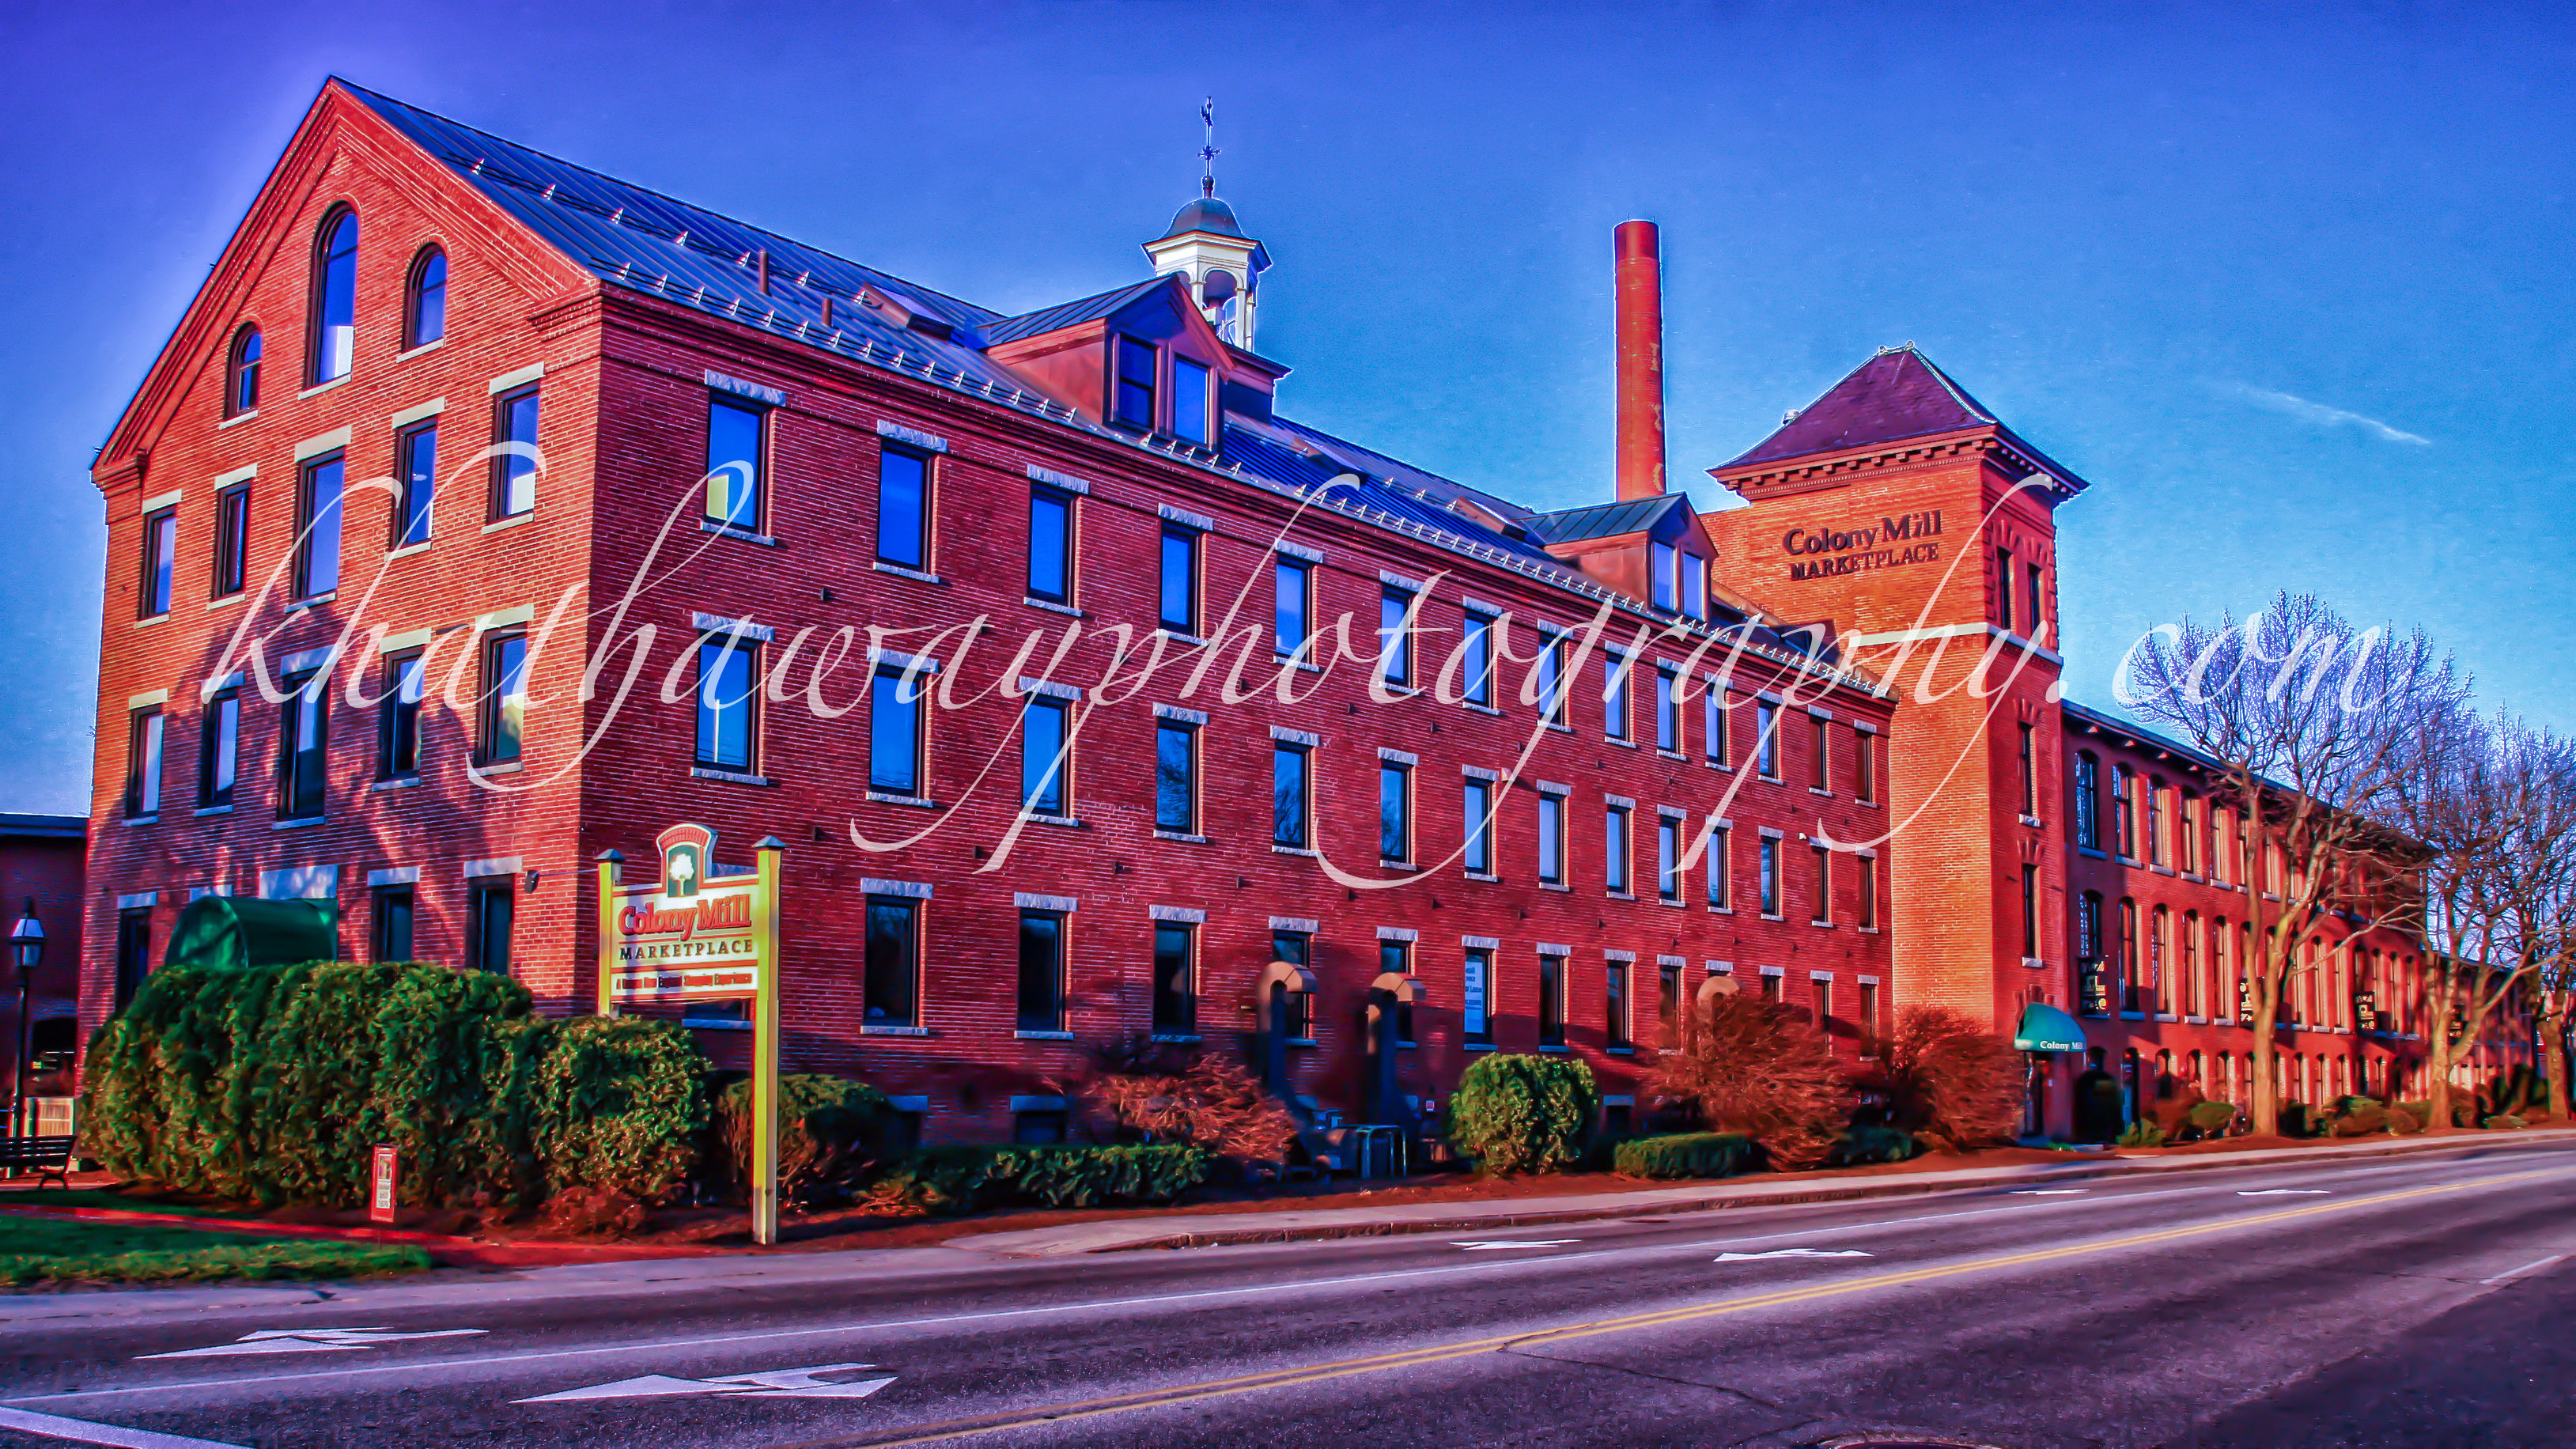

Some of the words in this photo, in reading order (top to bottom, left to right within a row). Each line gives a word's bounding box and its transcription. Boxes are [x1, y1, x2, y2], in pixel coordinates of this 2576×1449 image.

[1784, 528, 1879, 555] Colony
[1882, 509, 1942, 543] Mill
[1790, 543, 1939, 581] MARKETPLACE
[618, 902, 697, 941] Colony
[697, 894, 751, 931] Mill
[619, 940, 753, 960] MARKETPLACE
[2040, 1040, 2070, 1051] Colony
